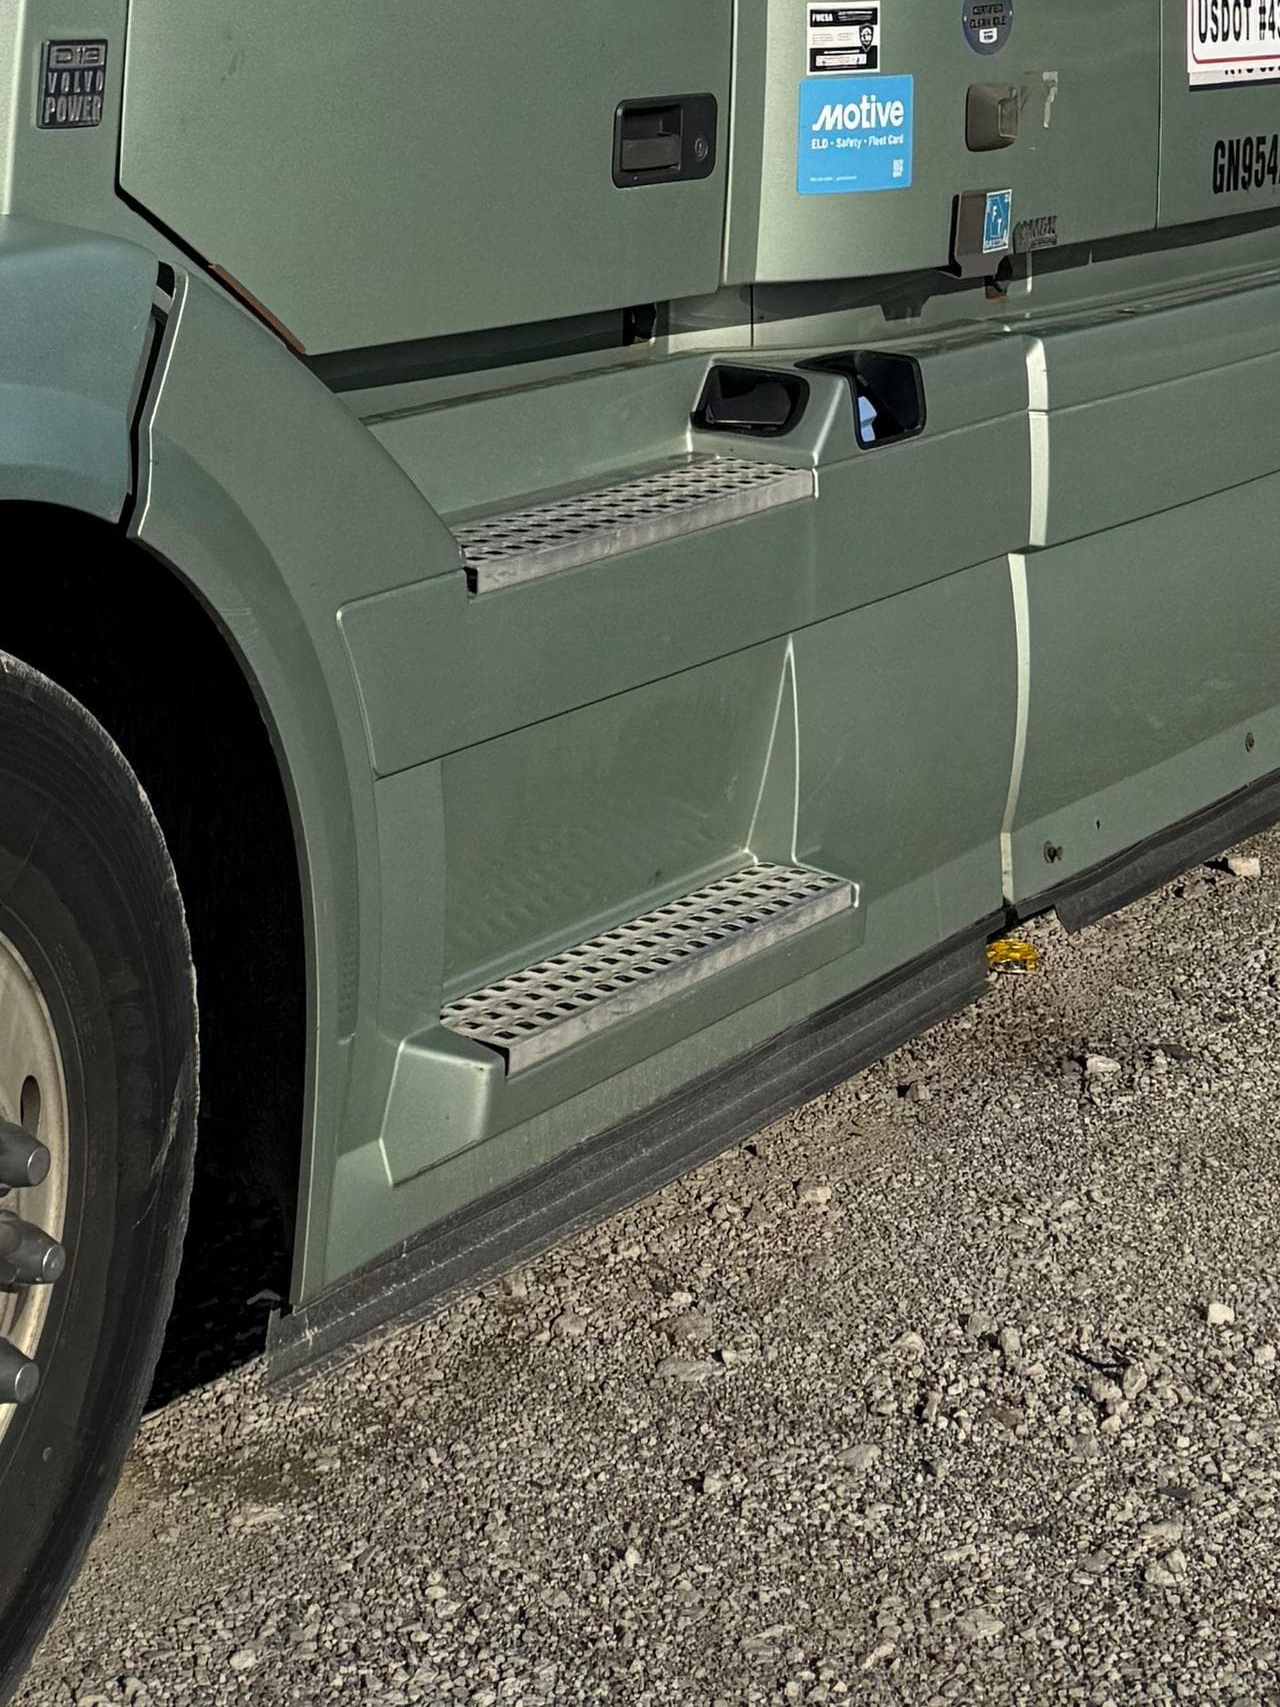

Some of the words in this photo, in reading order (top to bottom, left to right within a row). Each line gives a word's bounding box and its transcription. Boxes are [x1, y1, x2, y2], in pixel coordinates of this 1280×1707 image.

[47, 71, 104, 93] VOLVO
[44, 95, 102, 124] POWER
[811, 138, 828, 149] ELD
[836, 137, 862, 149] Safety
[868, 135, 887, 146] Fleet
[888, 134, 904, 145] Card
